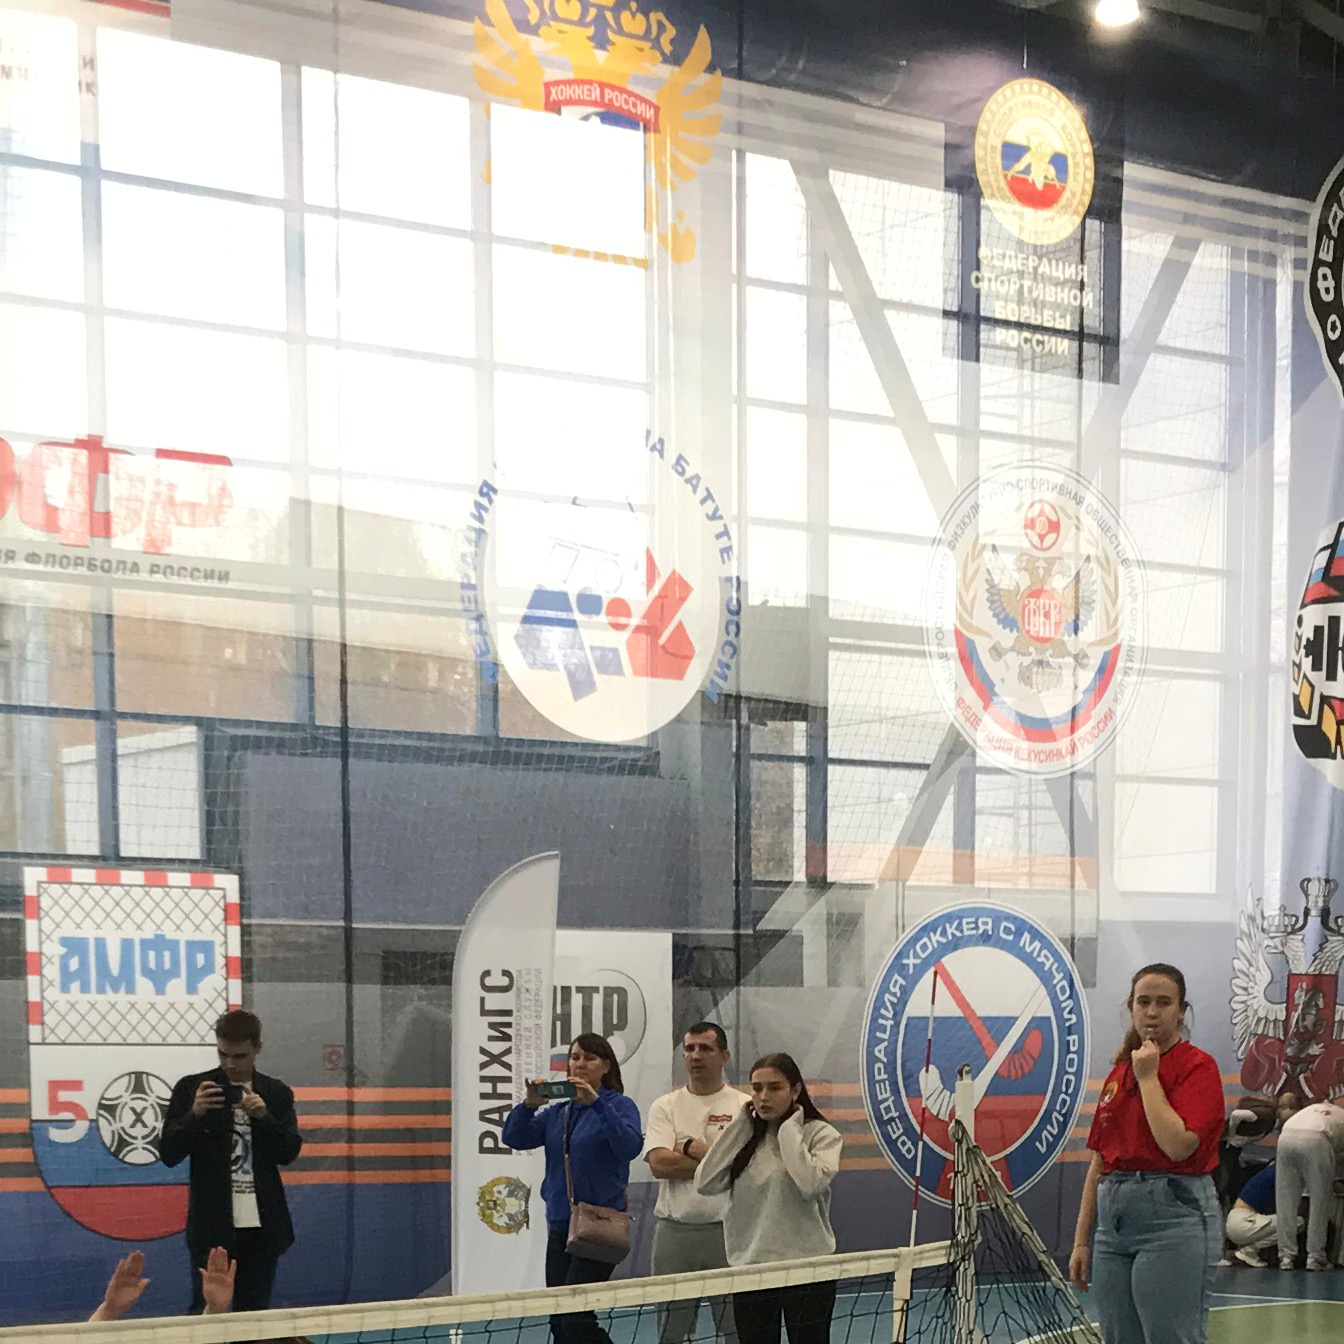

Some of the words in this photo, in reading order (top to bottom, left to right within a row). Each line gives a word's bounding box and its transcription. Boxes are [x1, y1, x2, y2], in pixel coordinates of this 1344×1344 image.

[549, 82, 601, 103] ХОККЕЙ
[604, 87, 655, 123] РОССИИ
[970, 271, 1094, 309] СПОРТИВНОЙ
[977, 245, 1088, 282] ФЕДЕРАЦИЯ
[994, 300, 1071, 331] БОРЬБЫ
[995, 327, 1069, 355] РОССИИ
[671, 452, 734, 565] БАТУТЕ
[24, 551, 141, 577] ФЛОРБОЛА
[147, 562, 231, 584] РОССИИ
[1078, 706, 1116, 750] РОССИИ
[902, 916, 993, 975] ХОККЕЯ
[999, 921, 1015, 941] С
[58, 933, 216, 996] АМФР
[1019, 931, 1079, 1028] МЯЧОМ
[551, 985, 628, 1049] НТР
[478, 968, 516, 1156] РАНХиГС
[874, 973, 917, 1160] ФЕДЕРАЦИЯ
[47, 1080, 89, 1144] 5
[1036, 1035, 1079, 1155] РОССИИ
